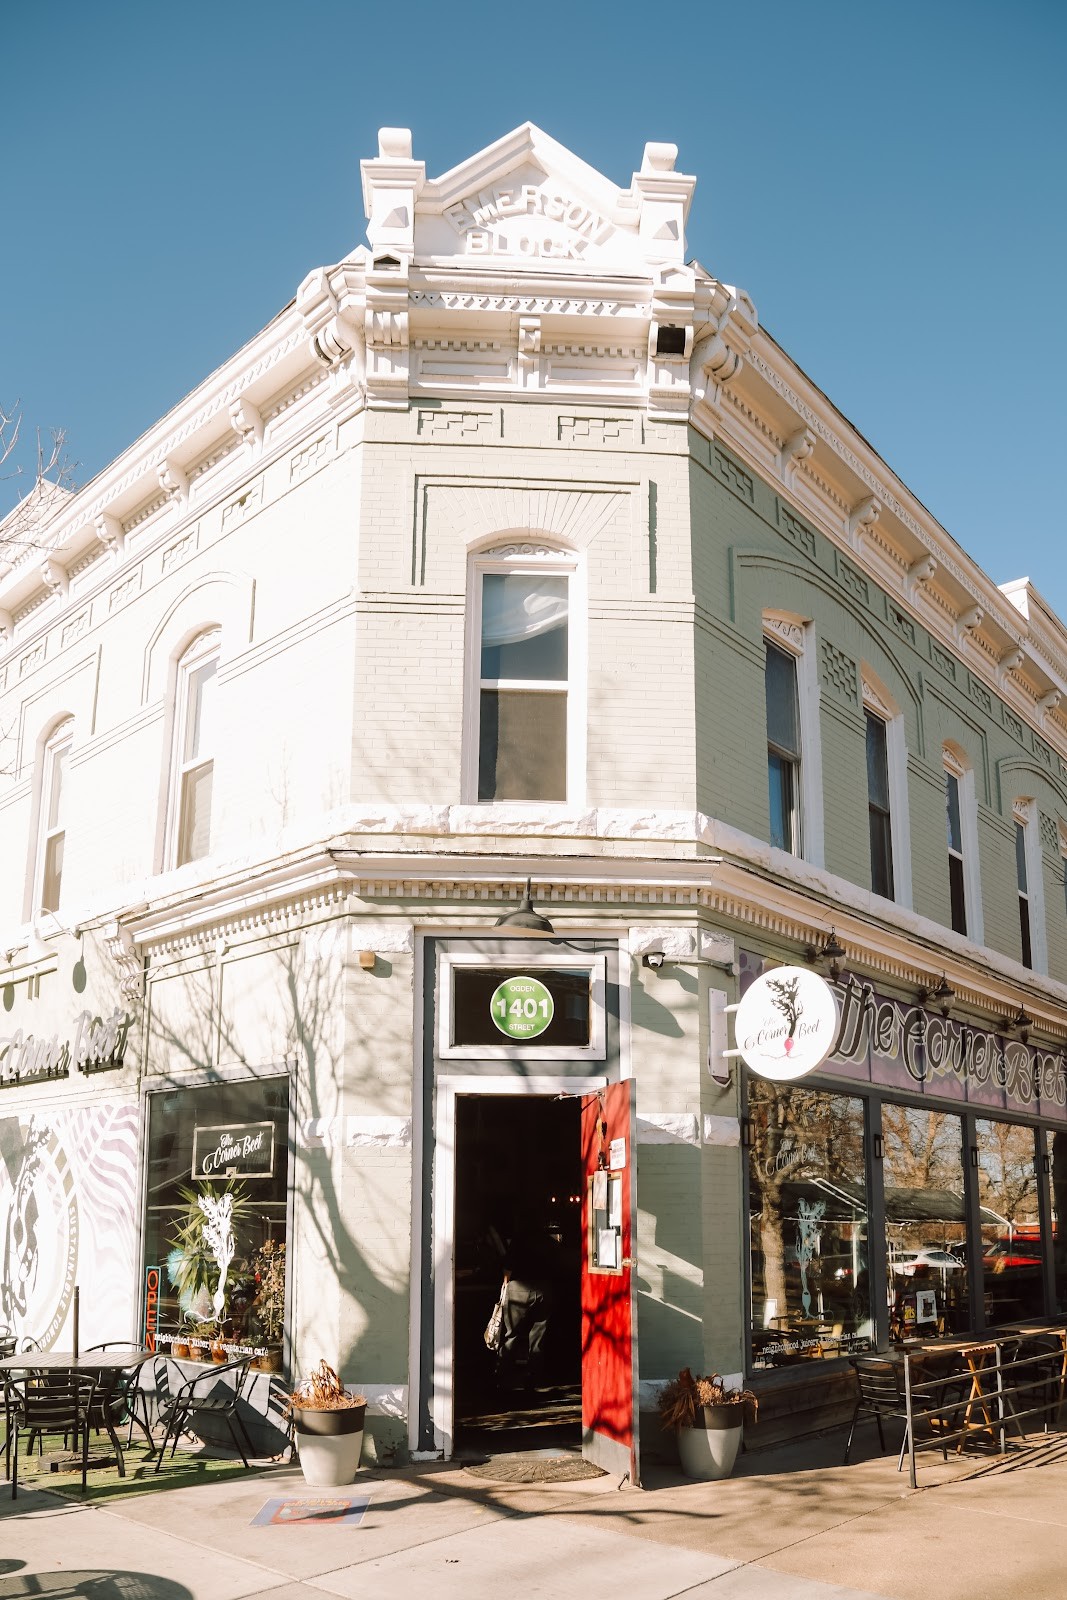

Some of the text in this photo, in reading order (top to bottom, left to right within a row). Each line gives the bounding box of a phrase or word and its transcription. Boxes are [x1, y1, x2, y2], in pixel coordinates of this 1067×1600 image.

[443, 185, 616, 246] EMERSON
[466, 230, 588, 260] BLOCK
[496, 998, 549, 1018] 1401
[508, 1023, 535, 1031] STREET
[744, 1019, 820, 1050] Corner Beet
[203, 1131, 264, 1173] Corner Beet
[220, 1133, 233, 1148] The
[59, 1206, 77, 1311] SUSTAINABLE
[146, 1270, 158, 1353] OPEN
[154, 1333, 189, 1345] neighborhood
[219, 1343, 253, 1355] vegetarian
